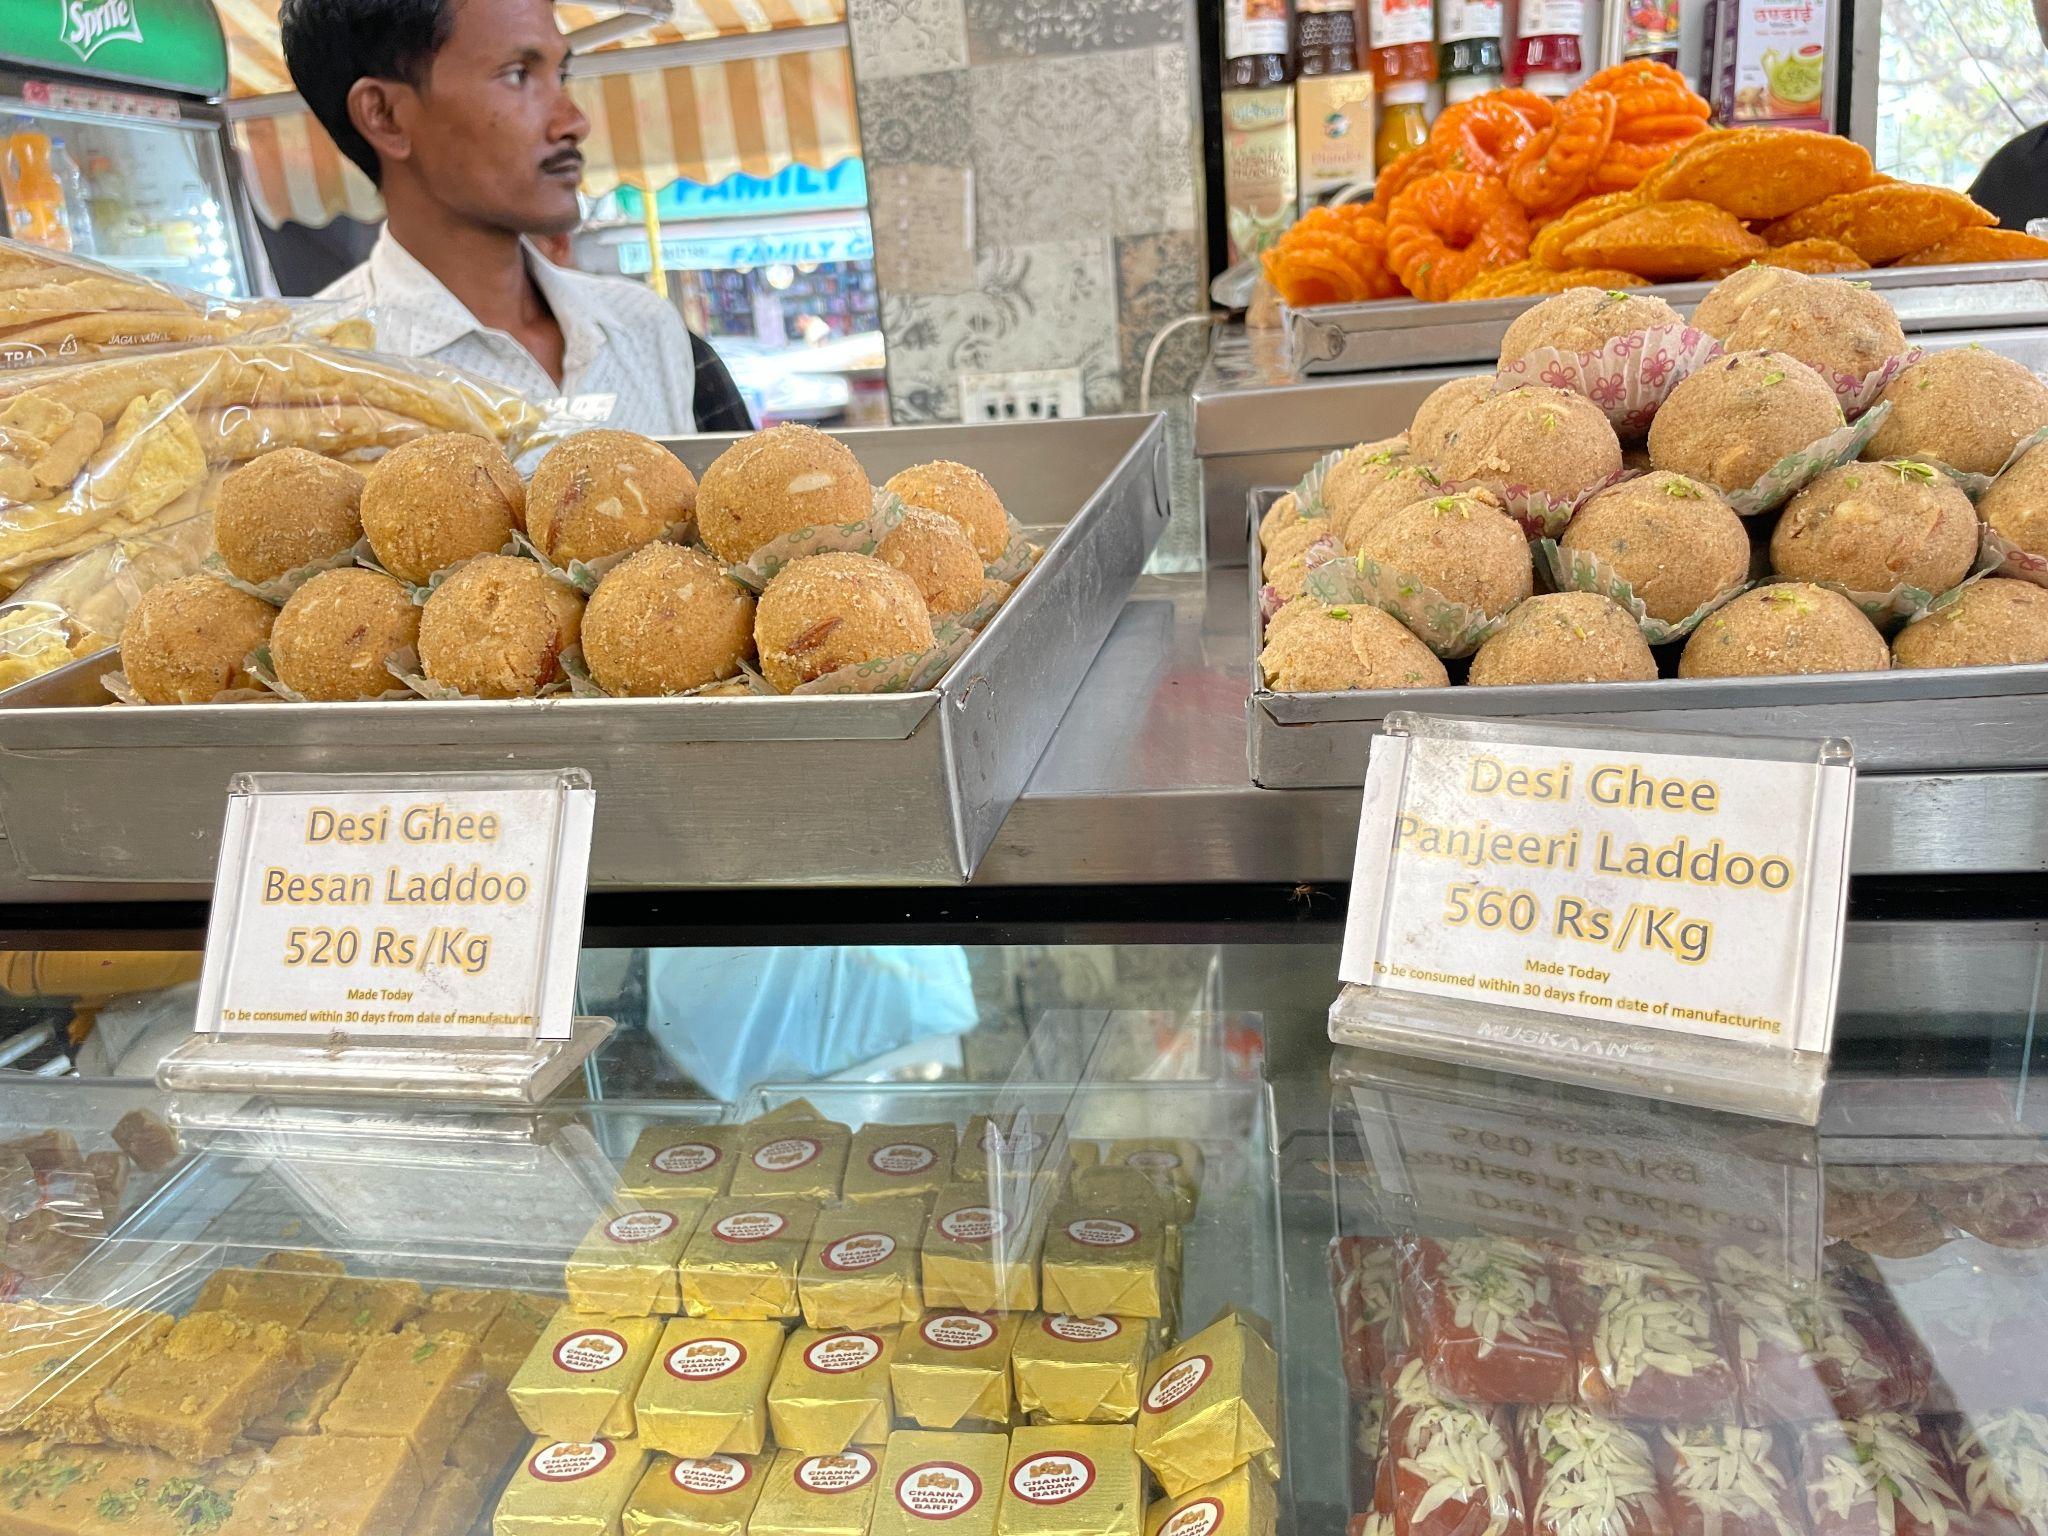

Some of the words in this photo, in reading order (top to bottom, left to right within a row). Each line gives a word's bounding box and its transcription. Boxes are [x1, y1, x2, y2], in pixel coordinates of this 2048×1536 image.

[69, 0, 131, 48] Sprite
[676, 163, 845, 205] FAMILY
[730, 240, 836, 264] FAMILY
[1466, 756, 1573, 802] Desi
[1588, 766, 1721, 814] Ghee
[306, 806, 390, 844] Desi
[401, 805, 501, 844] Ghee
[1392, 813, 1581, 871] Panjeeri
[1597, 831, 1796, 892] Laddoo
[263, 866, 373, 905] Besan
[385, 862, 529, 905] Laddoo
[1443, 886, 1538, 934] 560
[1554, 899, 1713, 963] Rs/Kg
[283, 928, 361, 968] 520
[371, 927, 491, 977] Rs/Kg
[1526, 959, 1564, 976] Made
[1568, 965, 1611, 985] Today
[347, 989, 377, 1000] Made
[381, 988, 413, 1002] Today
[1391, 964, 1406, 977] be
[1410, 970, 1475, 988] consumed
[1479, 976, 1520, 995] within
[1523, 983, 1541, 997] 30
[1544, 985, 1575, 1002] days
[1579, 991, 1612, 1008] from
[1617, 996, 1649, 1012] date
[1653, 1003, 1669, 1014] of
[1672, 1006, 1781, 1033] manufacturing
[223, 1010, 235, 1020] To
[238, 1010, 251, 1021] be
[253, 1010, 307, 1022] consumed
[310, 1011, 342, 1022] within
[345, 1012, 359, 1022] 30
[361, 1011, 385, 1024] days
[388, 1012, 414, 1023] from
[417, 1012, 441, 1023] date
[444, 1010, 457, 1023] of
[836, 1248, 885, 1257] CHANNA
[840, 1252, 881, 1261] BADAM
[843, 1257, 877, 1265] BARFI
[932, 1328, 983, 1337] CHANNA
[1057, 1323, 1108, 1333] CHANNA
[935, 1333, 977, 1341] BADAM
[566, 1349, 610, 1361] CHANNA
[566, 1354, 604, 1364] BADAM
[817, 1351, 869, 1359] CHANNA
[566, 1359, 597, 1368] BARFI
[1155, 1370, 1199, 1401] CHANNA
[1159, 1377, 1196, 1403] BADAM
[542, 1456, 596, 1465] CHANNA
[545, 1461, 590, 1469] BADAM
[547, 1466, 585, 1474] BARFI
[682, 1469, 733, 1481] CHANNA
[684, 1475, 727, 1485] BADAM
[684, 1480, 720, 1489] BARFI
[1022, 1475, 1080, 1487] CHANNA
[1028, 1482, 1075, 1492] BADAM
[1032, 1488, 1072, 1497] BARFI
[908, 1490, 964, 1498] CHANNA
[914, 1503, 953, 1511] BARFI
